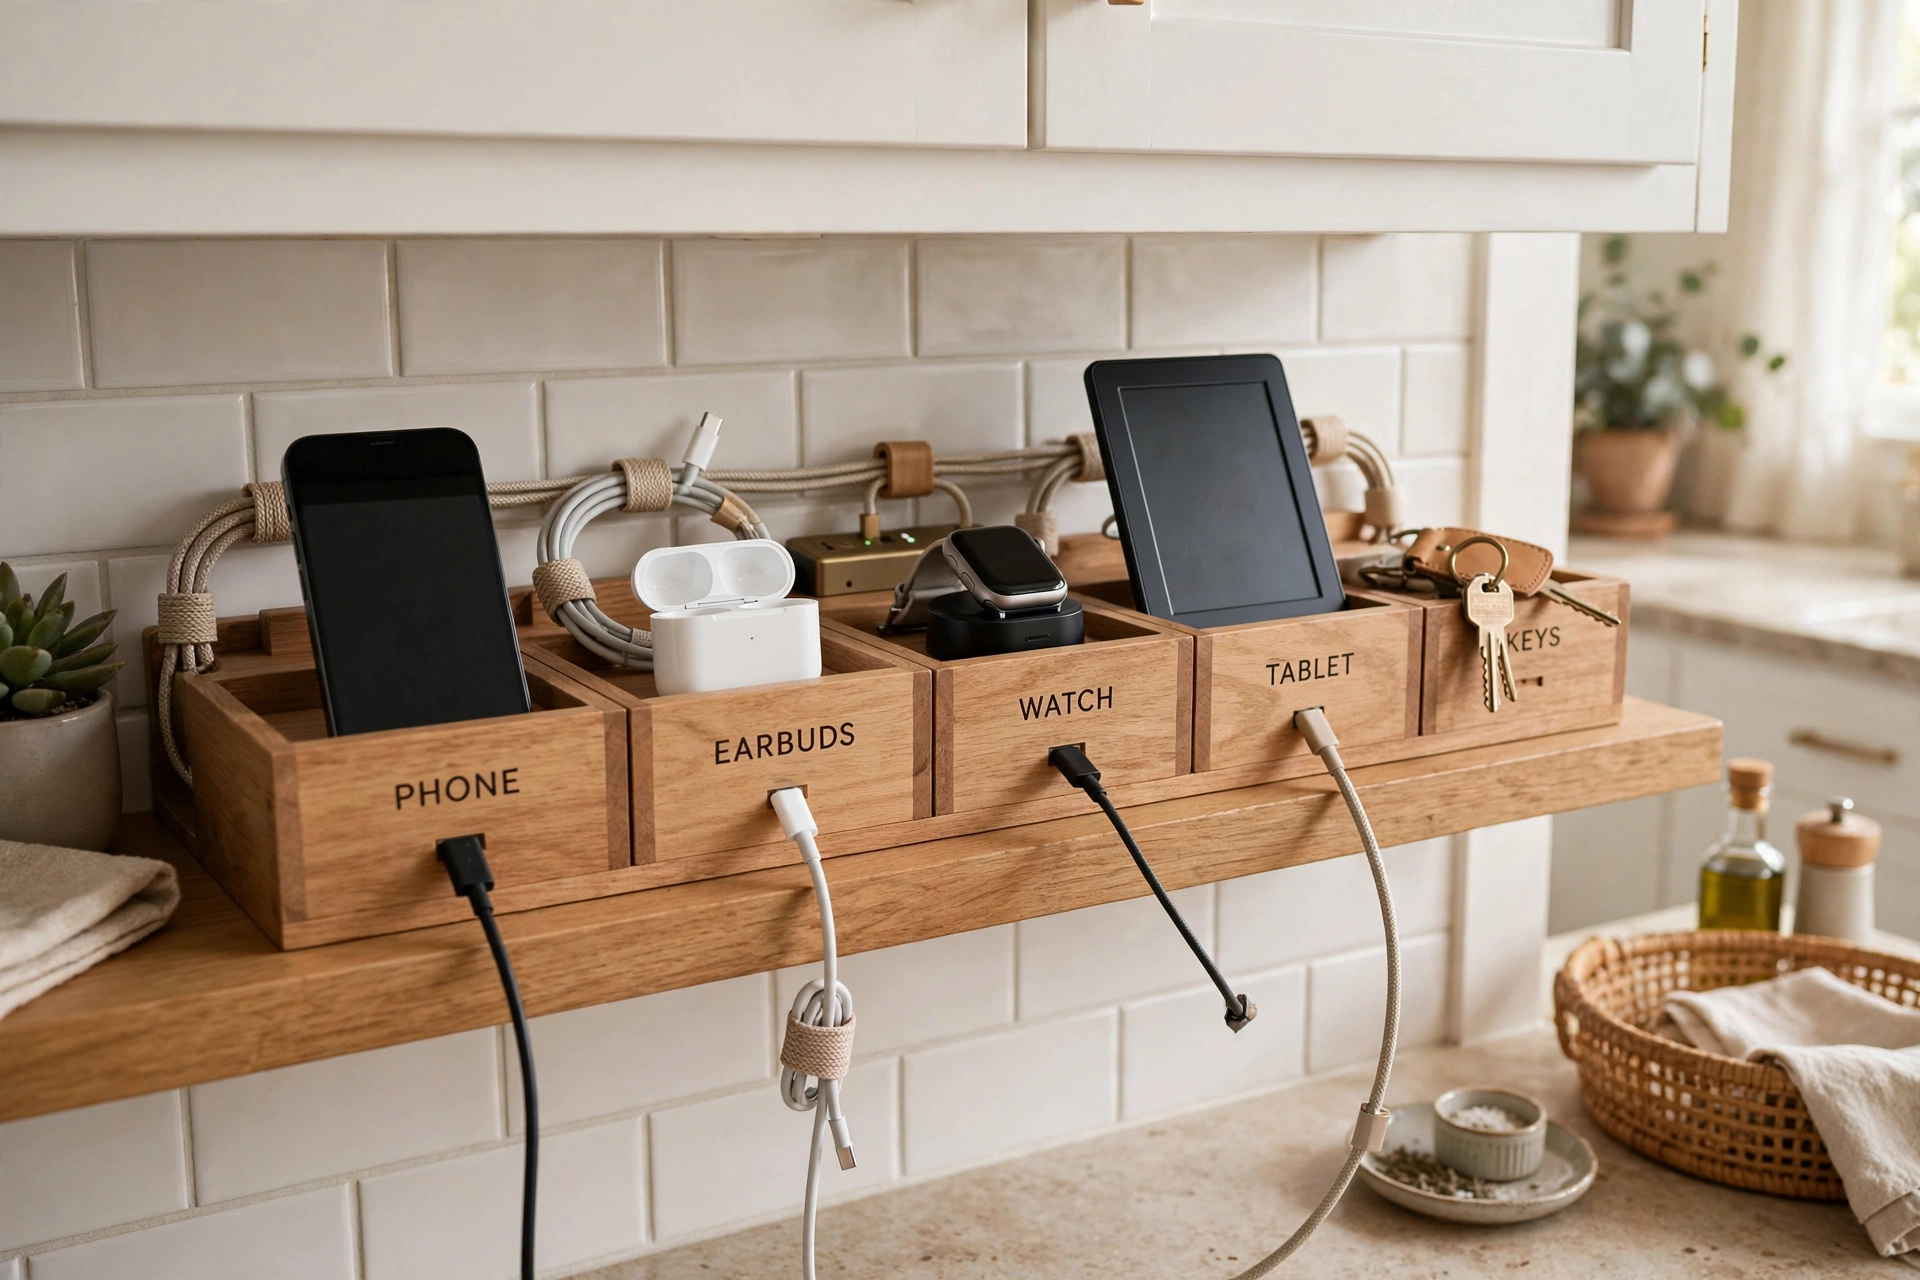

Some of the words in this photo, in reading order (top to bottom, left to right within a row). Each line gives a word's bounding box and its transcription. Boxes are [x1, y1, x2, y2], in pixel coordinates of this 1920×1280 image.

[1507, 626, 1561, 652] KEYS
[1265, 652, 1355, 686] TABLET
[1018, 685, 1114, 721] WATCH
[714, 722, 856, 765] EARBUDS
[394, 766, 521, 811] PHONE
